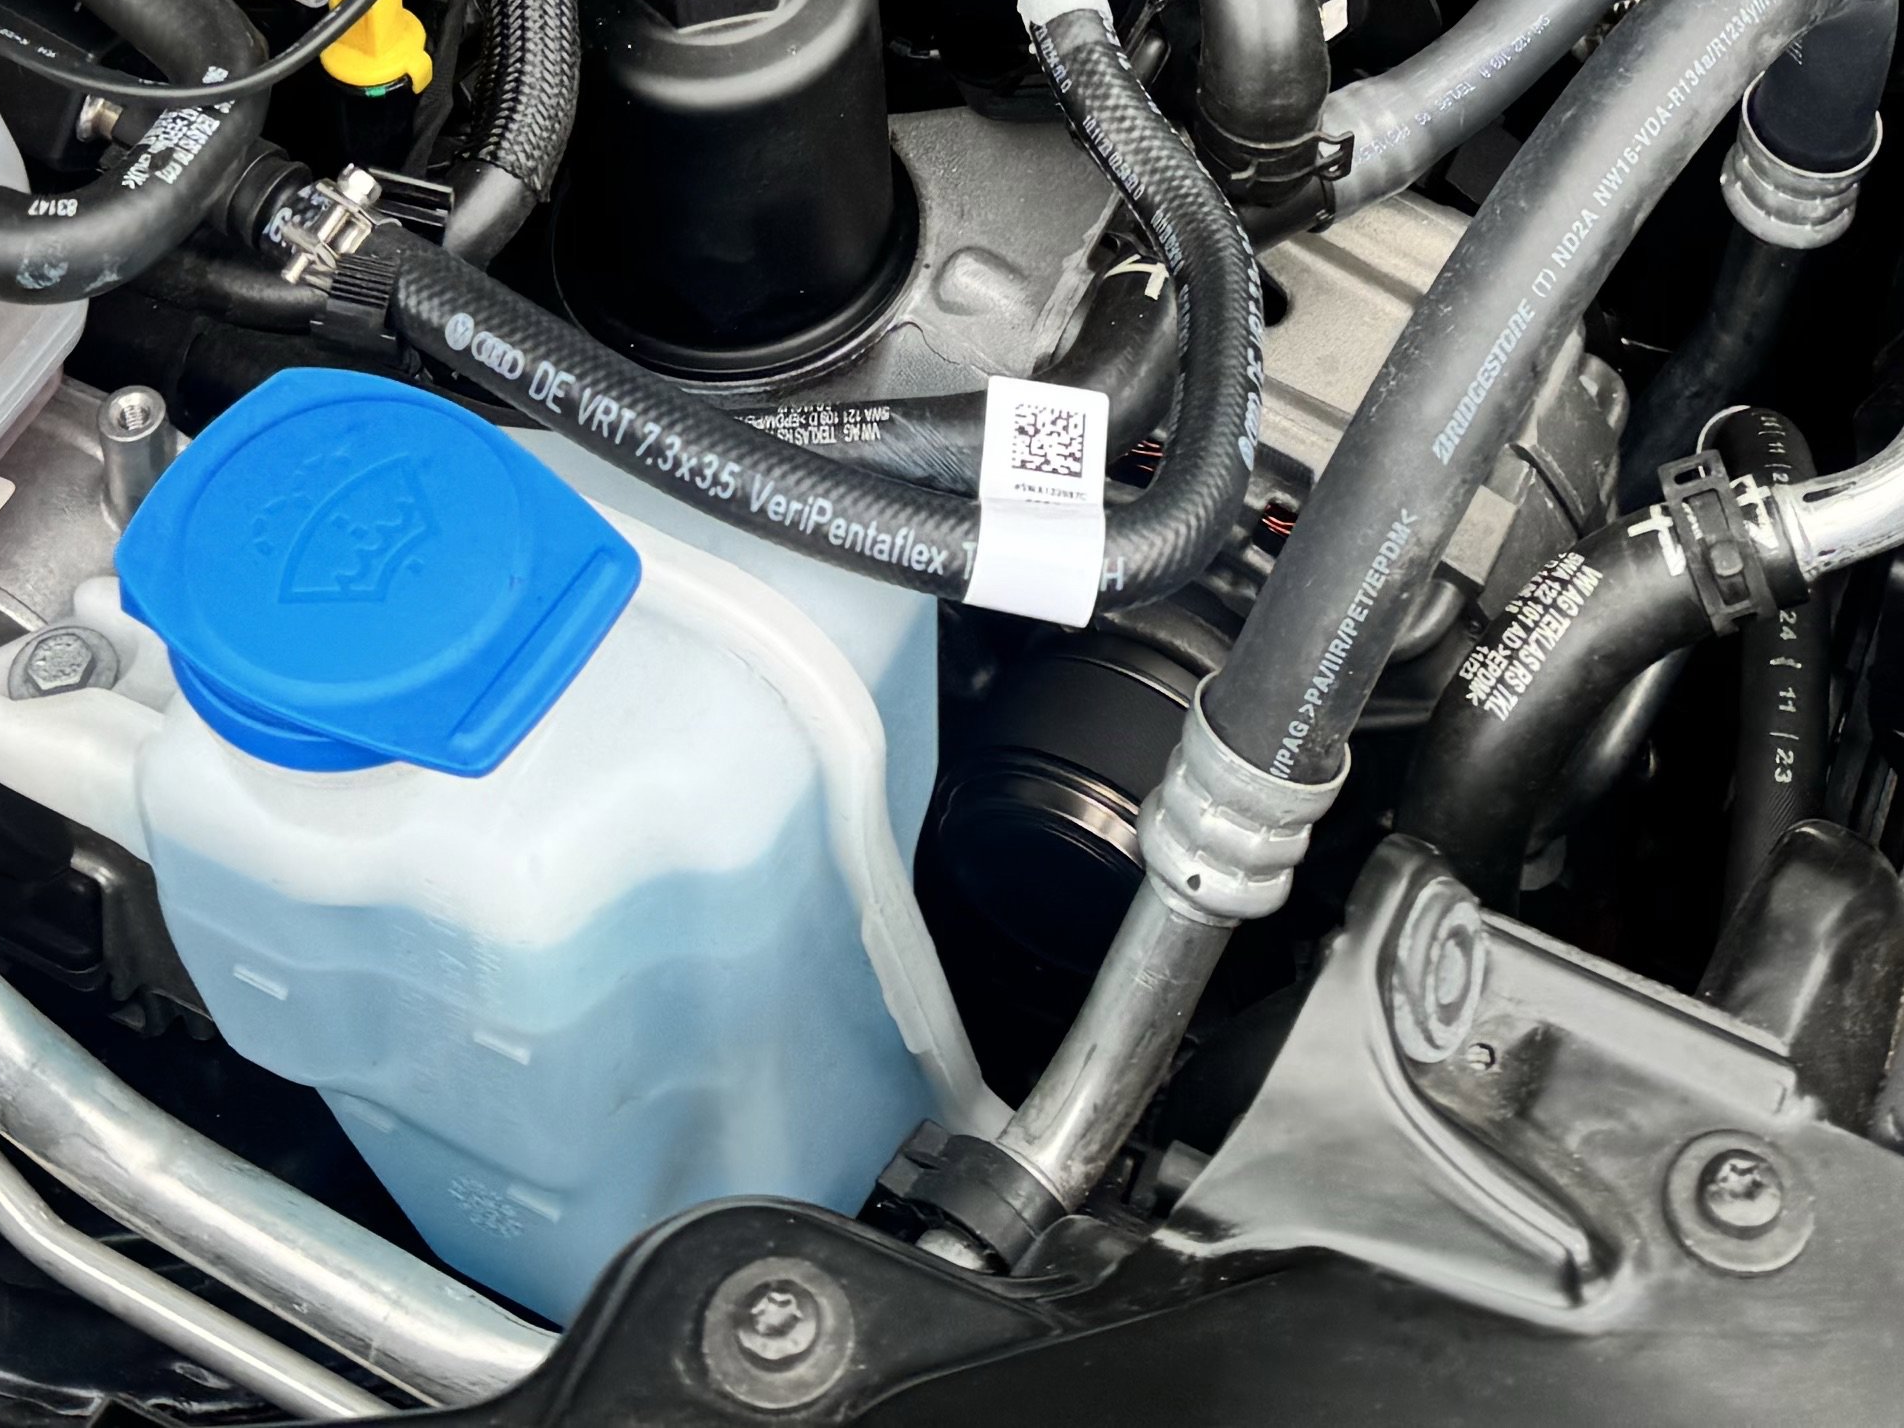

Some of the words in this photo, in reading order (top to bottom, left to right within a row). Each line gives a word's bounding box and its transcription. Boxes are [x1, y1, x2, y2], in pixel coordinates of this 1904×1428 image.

[1431, 297, 1537, 466] BRIDGESTONE
[1530, 267, 1557, 301] (T)
[1550, 207, 1599, 270] ND2A
[794, 425, 837, 446] TEKLAS
[861, 422, 882, 441] VW
[528, 360, 575, 414] DE
[577, 380, 637, 446] VRT
[748, 472, 949, 577] VeriPentaflex
[1551, 551, 1586, 581] 5WA
[1572, 565, 1604, 598] VW
[1533, 579, 1563, 605] 122
[1556, 584, 1585, 617] AG
[1501, 621, 1528, 650] AD
[1518, 607, 1572, 673] TEKLAS
[1503, 659, 1533, 694] RS
[1484, 683, 1519, 722] TKL
[1773, 747, 1795, 784] 23
